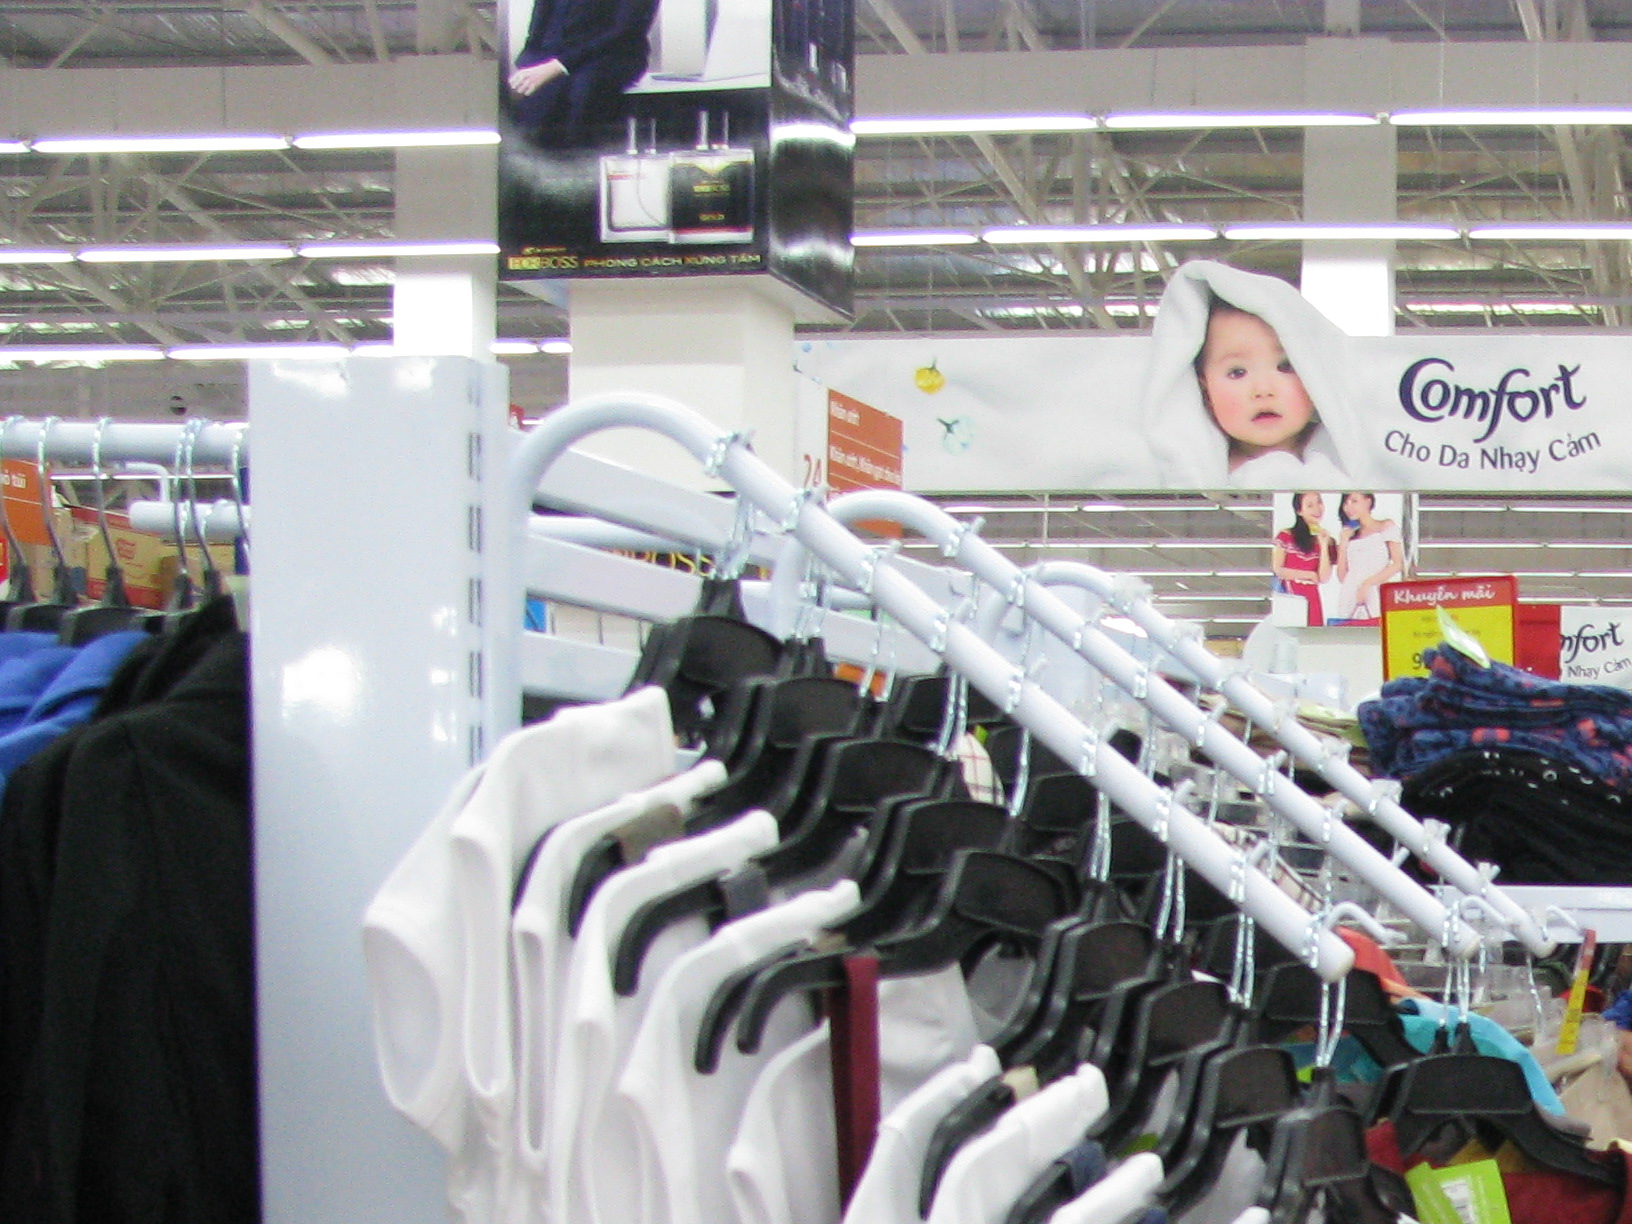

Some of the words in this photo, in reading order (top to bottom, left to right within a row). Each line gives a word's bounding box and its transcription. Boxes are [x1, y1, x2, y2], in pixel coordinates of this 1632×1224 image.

[1399, 357, 1587, 443] Comfort
[1384, 429, 1431, 462] Cho
[1438, 443, 1470, 469] Da
[1480, 445, 1541, 474] Nhạy
[1548, 431, 1602, 462] Cảm
[1393, 585, 1459, 606] Khuyến
[1462, 584, 1496, 601] mãi
